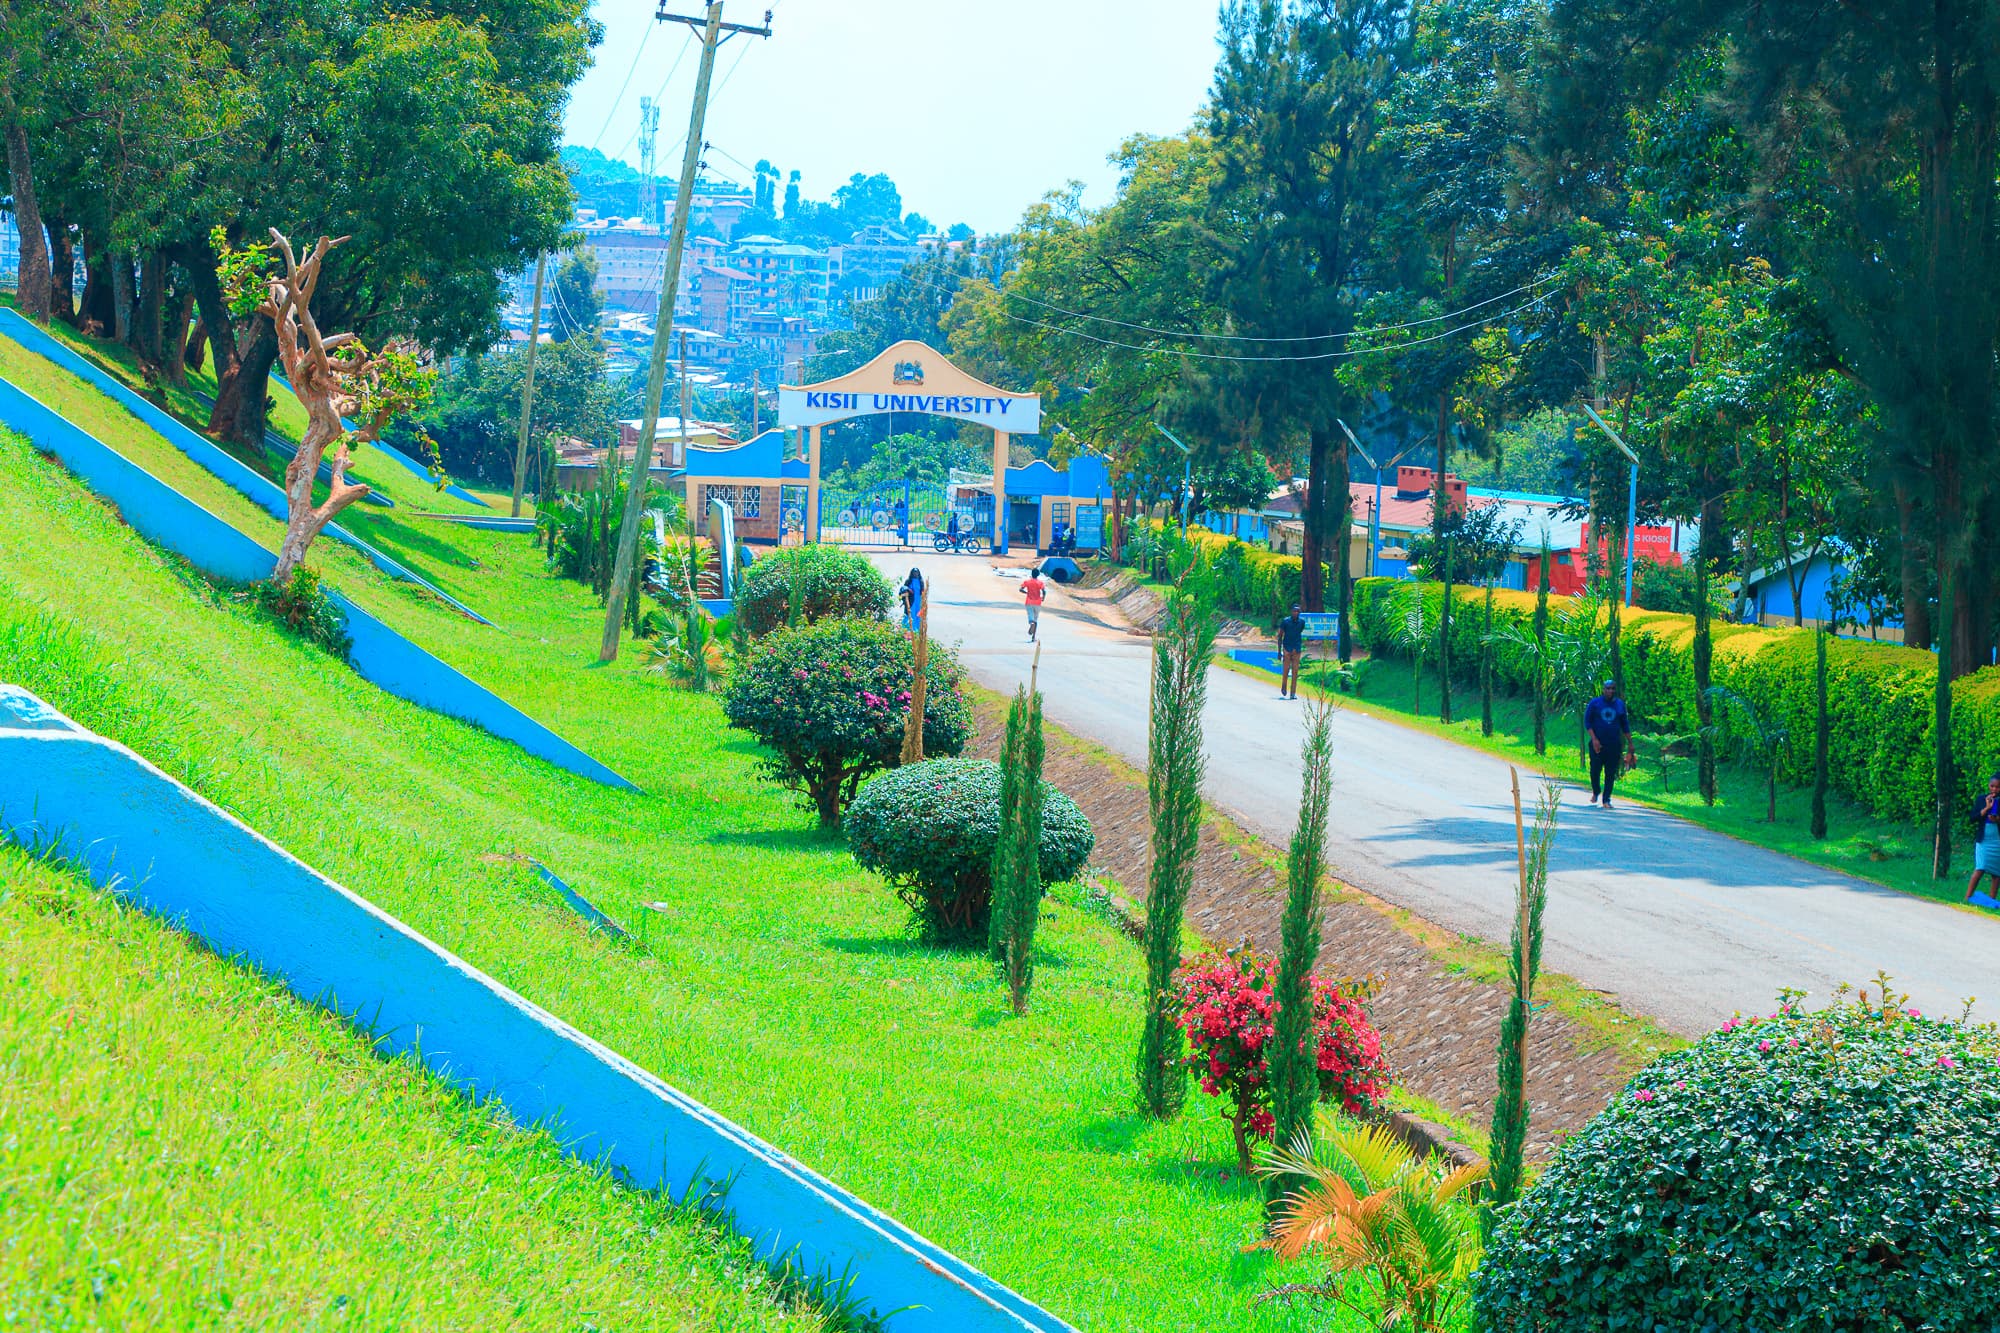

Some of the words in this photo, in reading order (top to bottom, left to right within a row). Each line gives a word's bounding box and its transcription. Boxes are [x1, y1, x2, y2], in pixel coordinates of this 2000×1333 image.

[806, 392, 858, 410] KISII
[873, 394, 1012, 414] UNIVERSITY
[1642, 534, 1669, 543] KIOSK
